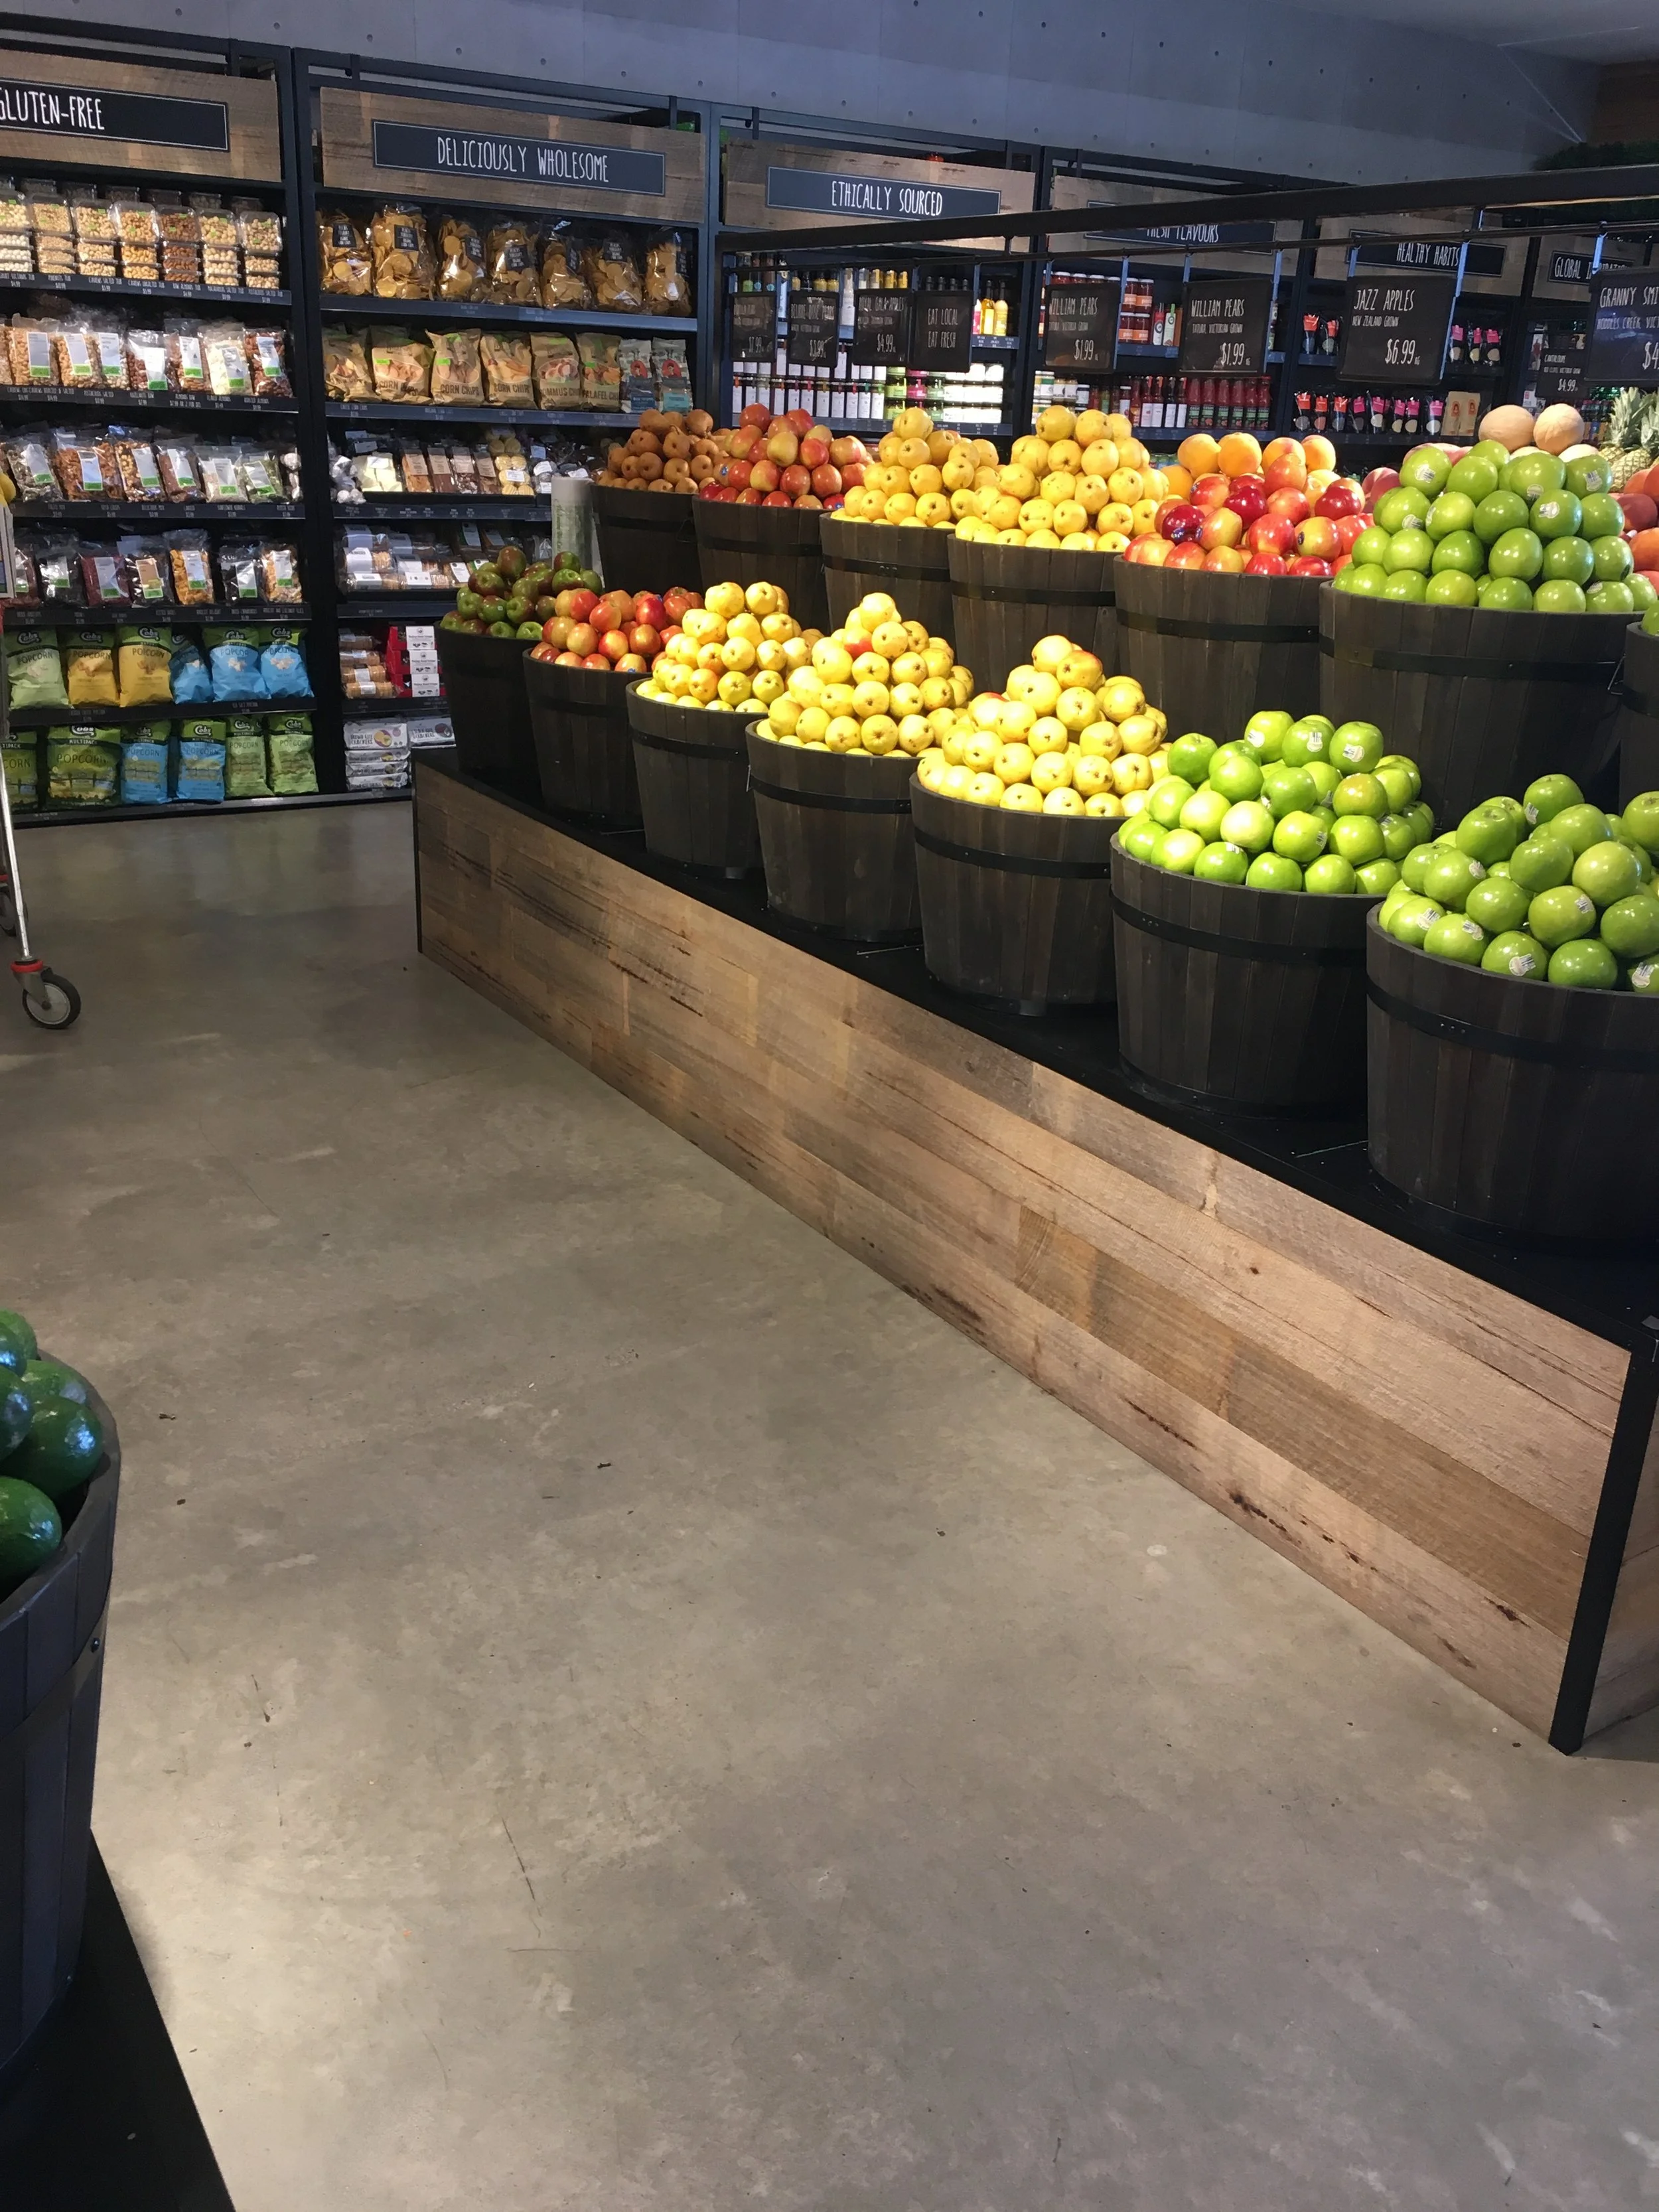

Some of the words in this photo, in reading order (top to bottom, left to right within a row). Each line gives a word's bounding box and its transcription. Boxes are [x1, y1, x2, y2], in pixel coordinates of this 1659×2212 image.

[0, 87, 105, 130] GLUTEN-FREE
[437, 136, 527, 173] DELICIOUSLY
[538, 147, 609, 183] WHOLESOME
[831, 181, 892, 210] ETHICALLY
[899, 188, 942, 216] SOURCED
[1396, 243, 1431, 263] HEALTHY
[1433, 246, 1460, 266] HABITS
[1555, 257, 1581, 279] GLOBAL
[1354, 289, 1379, 311] JAZZ
[1383, 289, 1415, 311] APPLES
[1599, 286, 1637, 308] GRANNY
[1049, 297, 1076, 315] WILLIAM
[1080, 297, 1098, 315] PEARS
[1191, 299, 1221, 317] WILLIAM
[1224, 299, 1245, 317] PEARS
[928, 308, 938, 325] EAT
[941, 308, 958, 325] LOCAL
[1352, 316, 1362, 327] NEW
[1362, 315, 1382, 327] ZEALAND
[1384, 316, 1400, 327] GROWN
[877, 334, 893, 353] $4.99
[928, 331, 938, 348] EAT
[940, 331, 956, 348] FRESH
[1221, 342, 1245, 366] $1.99
[1385, 338, 1415, 364] $6.99
[441, 384, 460, 394] CORN
[541, 388, 568, 397] OMMUS
[1557, 378, 1576, 392] $4.99
[139, 627, 160, 640] Cobs
[272, 627, 291, 638] Cobs
[17, 650, 53, 664] POPCORN
[74, 650, 111, 660] POPCORN
[194, 725, 212, 736] Cobs
[5, 759, 31, 769] CORN
